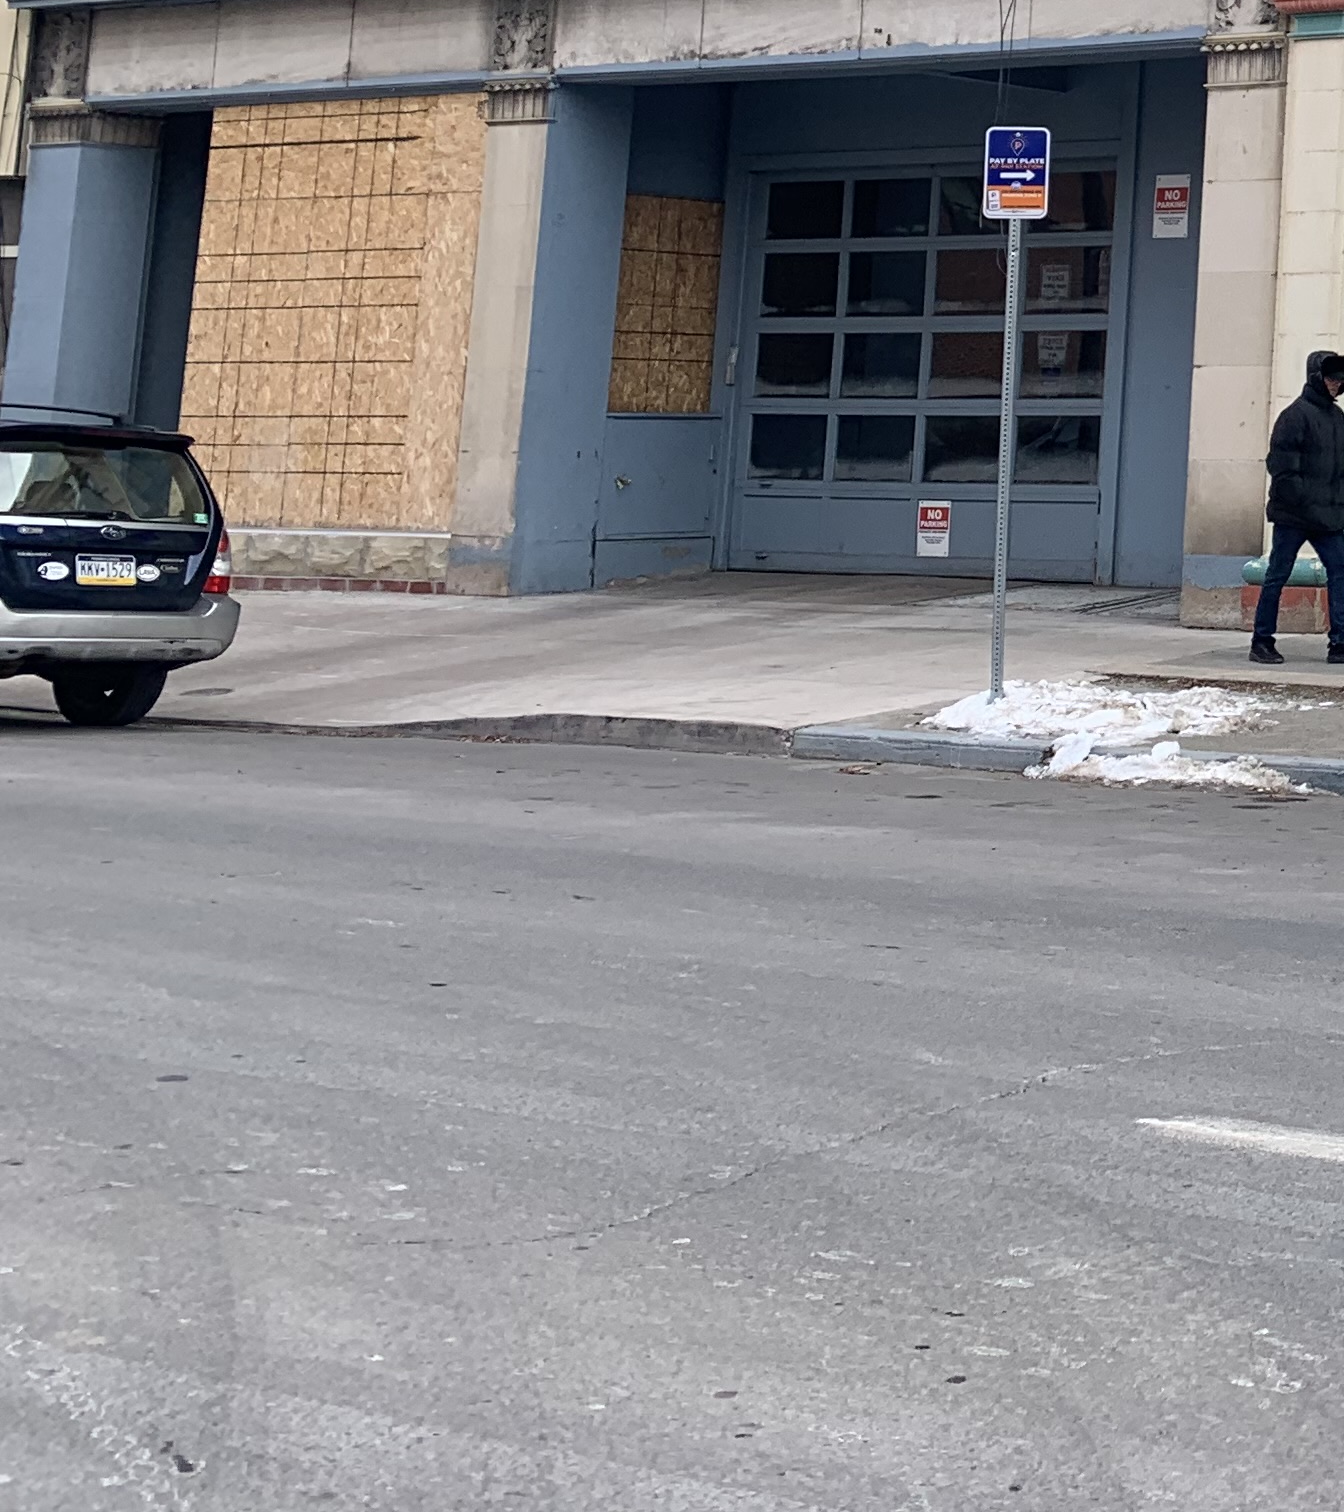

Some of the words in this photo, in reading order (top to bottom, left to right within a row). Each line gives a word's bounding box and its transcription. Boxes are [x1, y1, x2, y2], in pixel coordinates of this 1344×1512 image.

[1164, 189, 1181, 201] NO
[1156, 201, 1187, 209] PARKING
[926, 509, 943, 520] NO
[920, 520, 948, 528] PARKING
